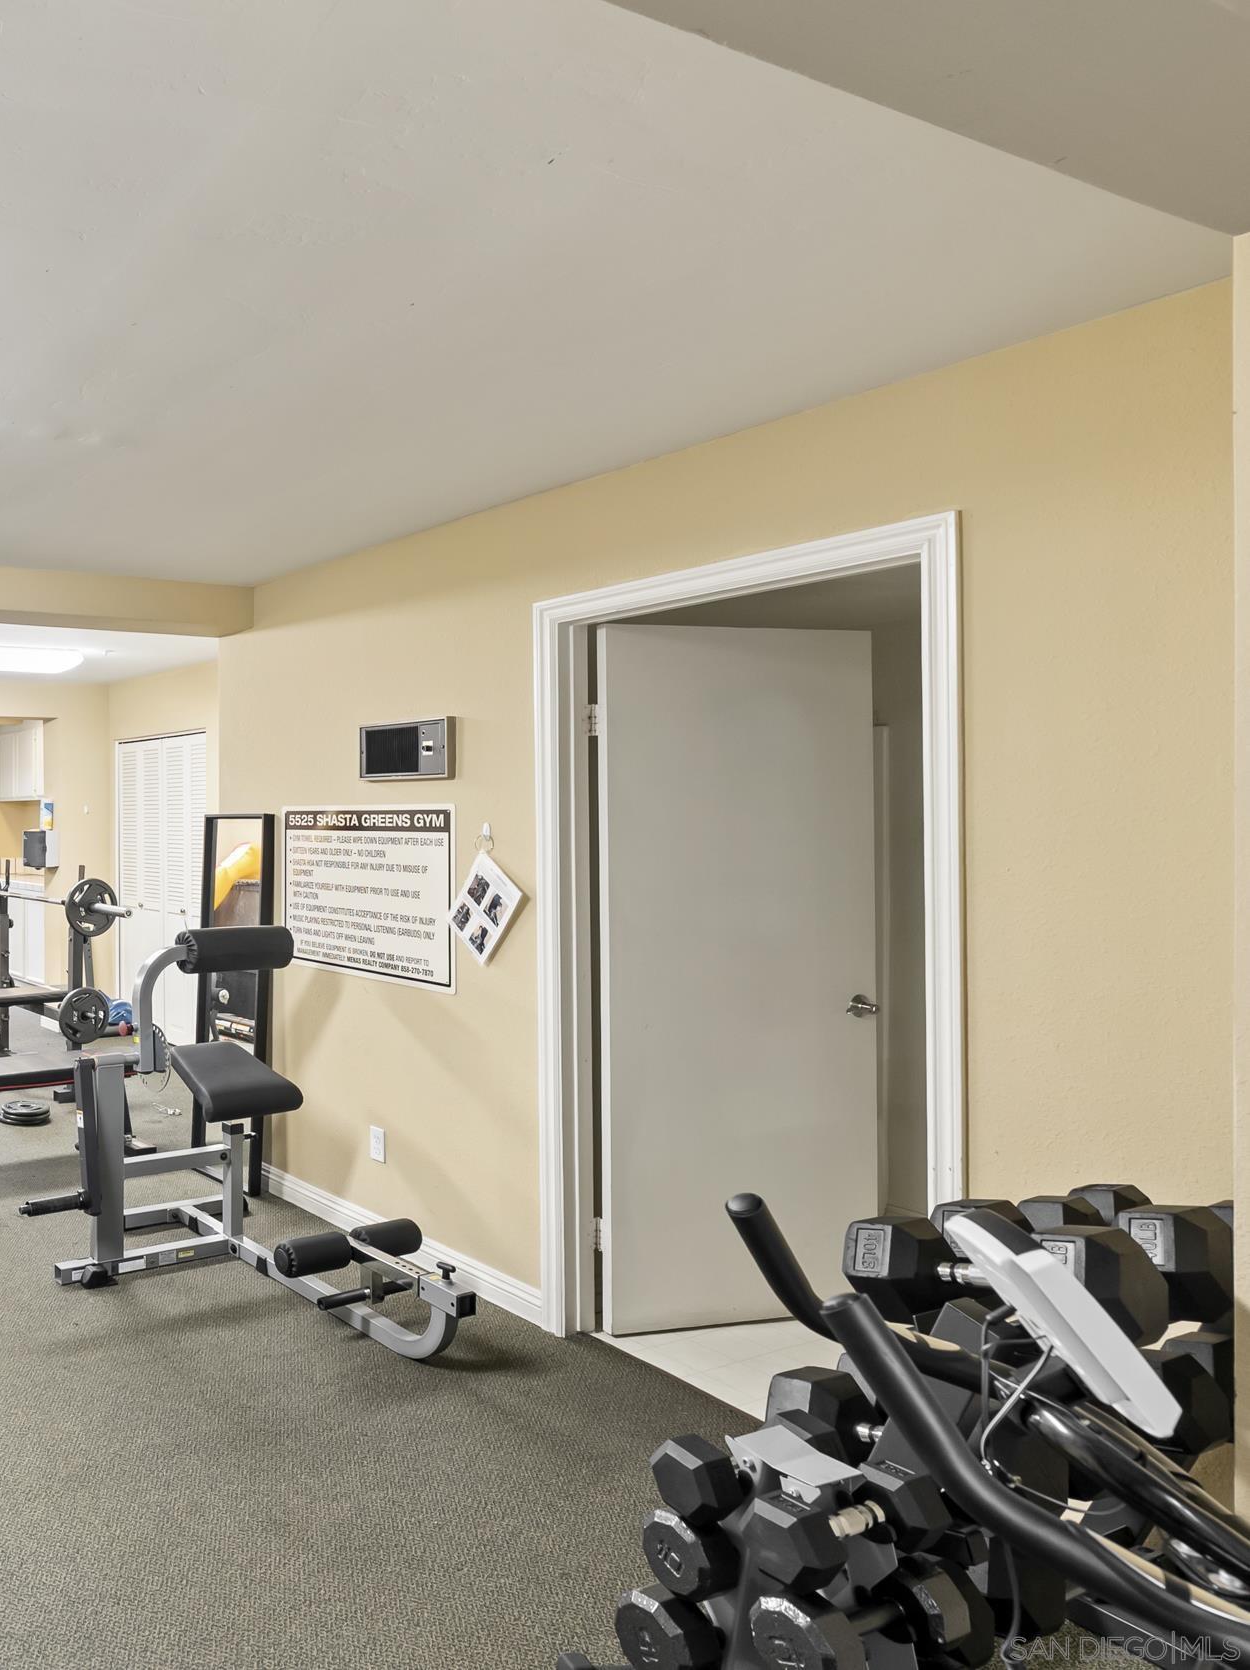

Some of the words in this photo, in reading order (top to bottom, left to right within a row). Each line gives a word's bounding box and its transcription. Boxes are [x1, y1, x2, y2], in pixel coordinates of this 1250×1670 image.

[289, 814, 314, 825] 5525
[316, 814, 358, 826] SHASTA
[362, 814, 410, 827] GREENS
[414, 814, 444, 827] GYM
[404, 838, 419, 846] AFTER
[434, 838, 444, 846] USE
[365, 850, 386, 858] CHILDREN
[324, 860, 350, 869] RESPONSIBLE
[396, 864, 401, 872] TO
[403, 865, 420, 873] MISUSE
[293, 881, 314, 889] FAMILIARIZE
[315, 882, 334, 890] YOURSELF
[346, 884, 368, 894] EQUIPMENT
[370, 887, 383, 896] PRIOR
[384, 888, 389, 896] TO
[390, 888, 399, 897] USE
[400, 889, 410, 898] AND
[411, 891, 420, 899] USE
[303, 892, 318, 900] CAUTION
[306, 904, 327, 913] EQUIPMENT
[328, 906, 354, 916] CONSTITUTES
[355, 909, 382, 920] ACCEPTANCE
[390, 914, 398, 922] THE
[400, 915, 410, 923] RISK
[419, 917, 436, 926] INJURY
[305, 916, 320, 924] PLAYING
[321, 917, 344, 928] RESTRICTED
[351, 922, 372, 932] PERSONAL
[374, 925, 396, 935] LISTENING
[397, 928, 422, 940] (EARBUDS)
[423, 932, 435, 940] ONLY
[322, 930, 335, 939] LIGHTS
[344, 933, 356, 942] WHEN
[357, 935, 374, 945] LEAVING
[312, 941, 325, 949] BELIEVE
[326, 943, 347, 952] EQUIPMENT
[386, 953, 394, 961] USE
[406, 956, 422, 965] REPORT
[297, 948, 320, 957] MANAGEMENT
[362, 959, 378, 967] REALTY
[379, 961, 400, 971] COMPANY
[401, 965, 434, 977] 858-270-7870
